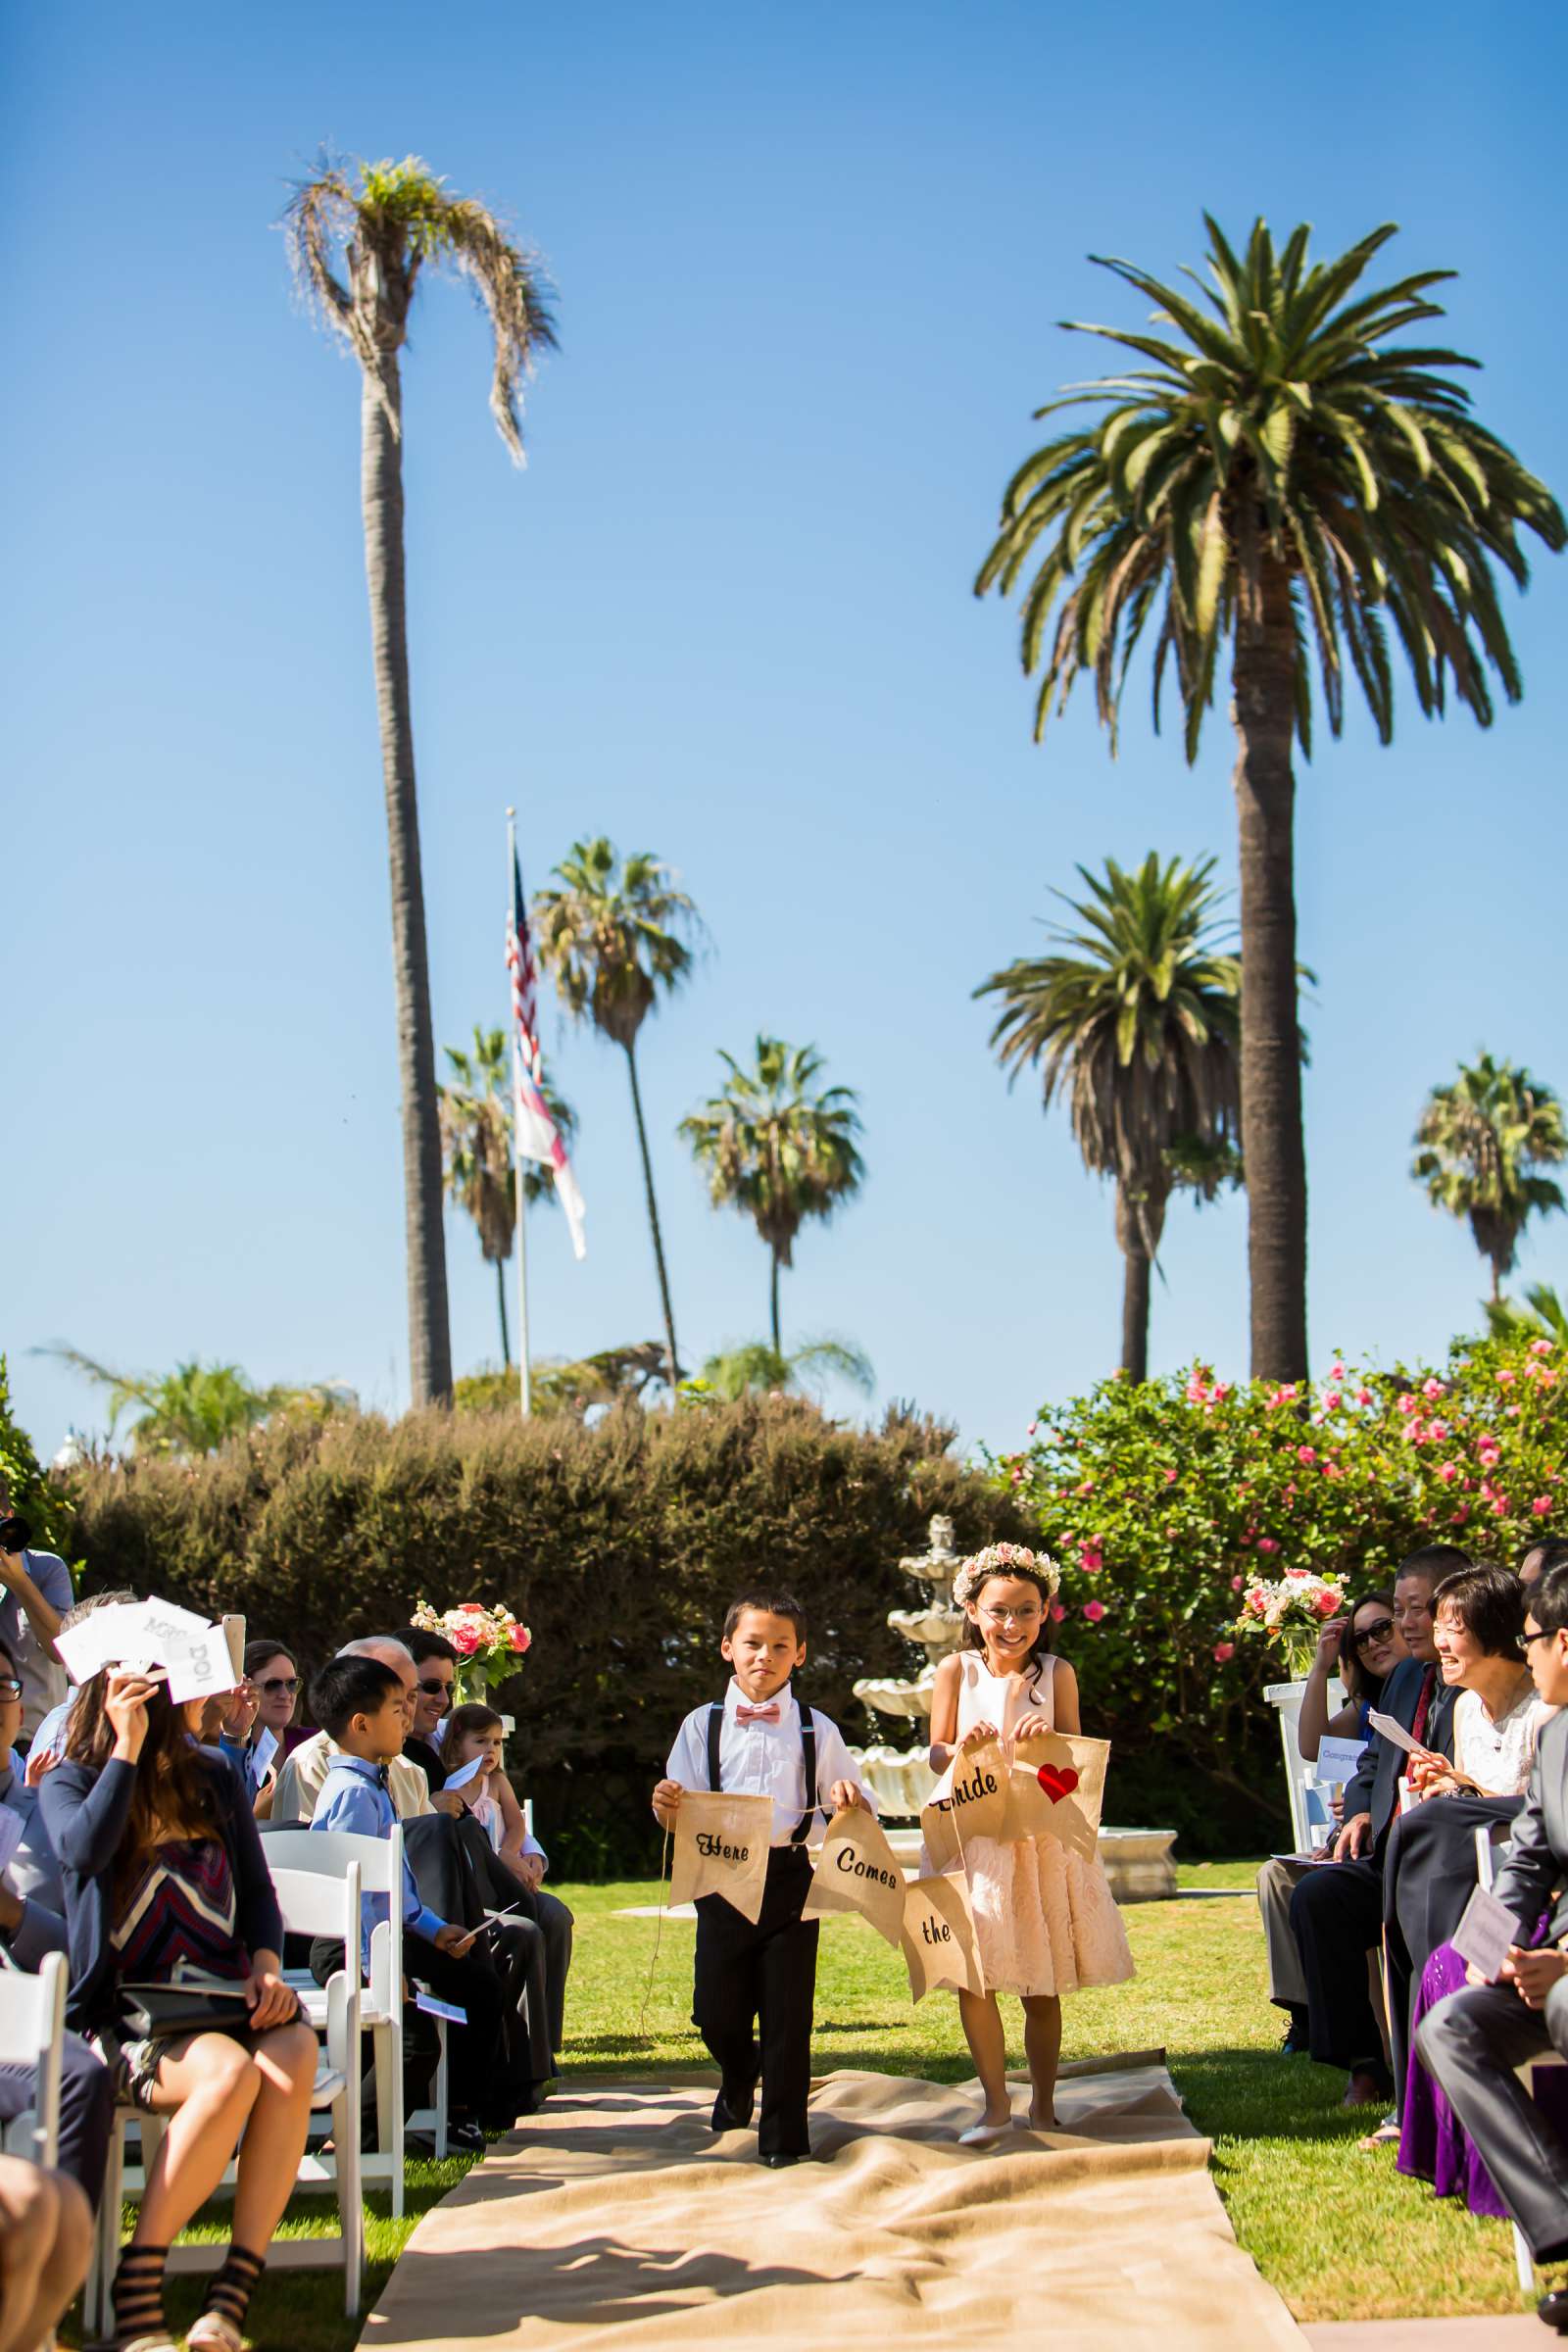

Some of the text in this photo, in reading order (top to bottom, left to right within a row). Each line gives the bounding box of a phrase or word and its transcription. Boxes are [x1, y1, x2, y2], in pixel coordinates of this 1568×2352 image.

[696, 1833, 749, 1862] Here
[836, 1846, 897, 1889] Comes
[922, 1915, 951, 1944] the
